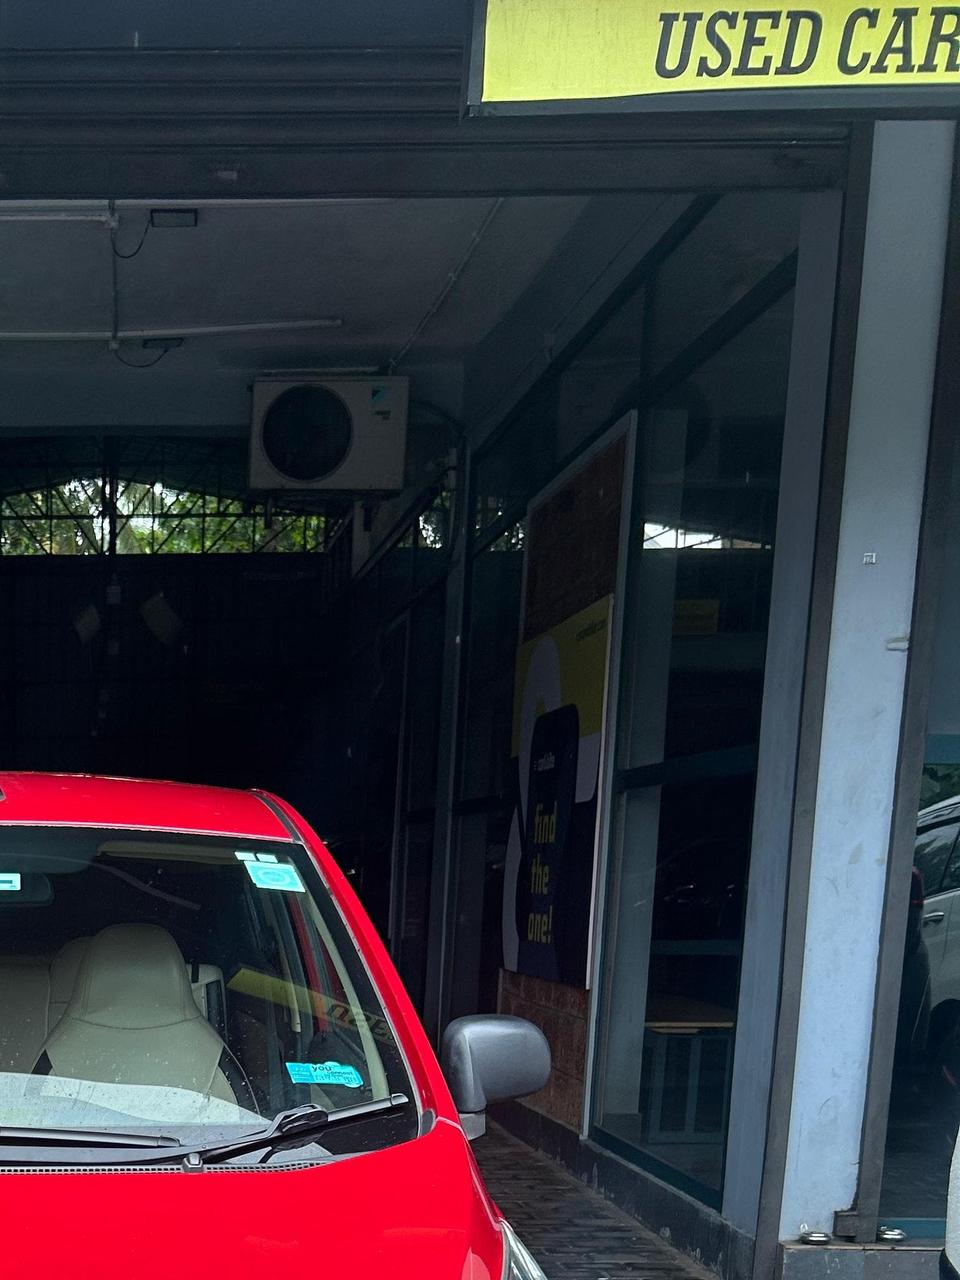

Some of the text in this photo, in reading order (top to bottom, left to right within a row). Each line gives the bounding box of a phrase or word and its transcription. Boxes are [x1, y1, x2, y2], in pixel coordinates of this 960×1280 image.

[655, 6, 960, 79] USED CAR
[534, 800, 558, 844] find
[530, 852, 550, 895] the
[527, 904, 553, 944] one!
